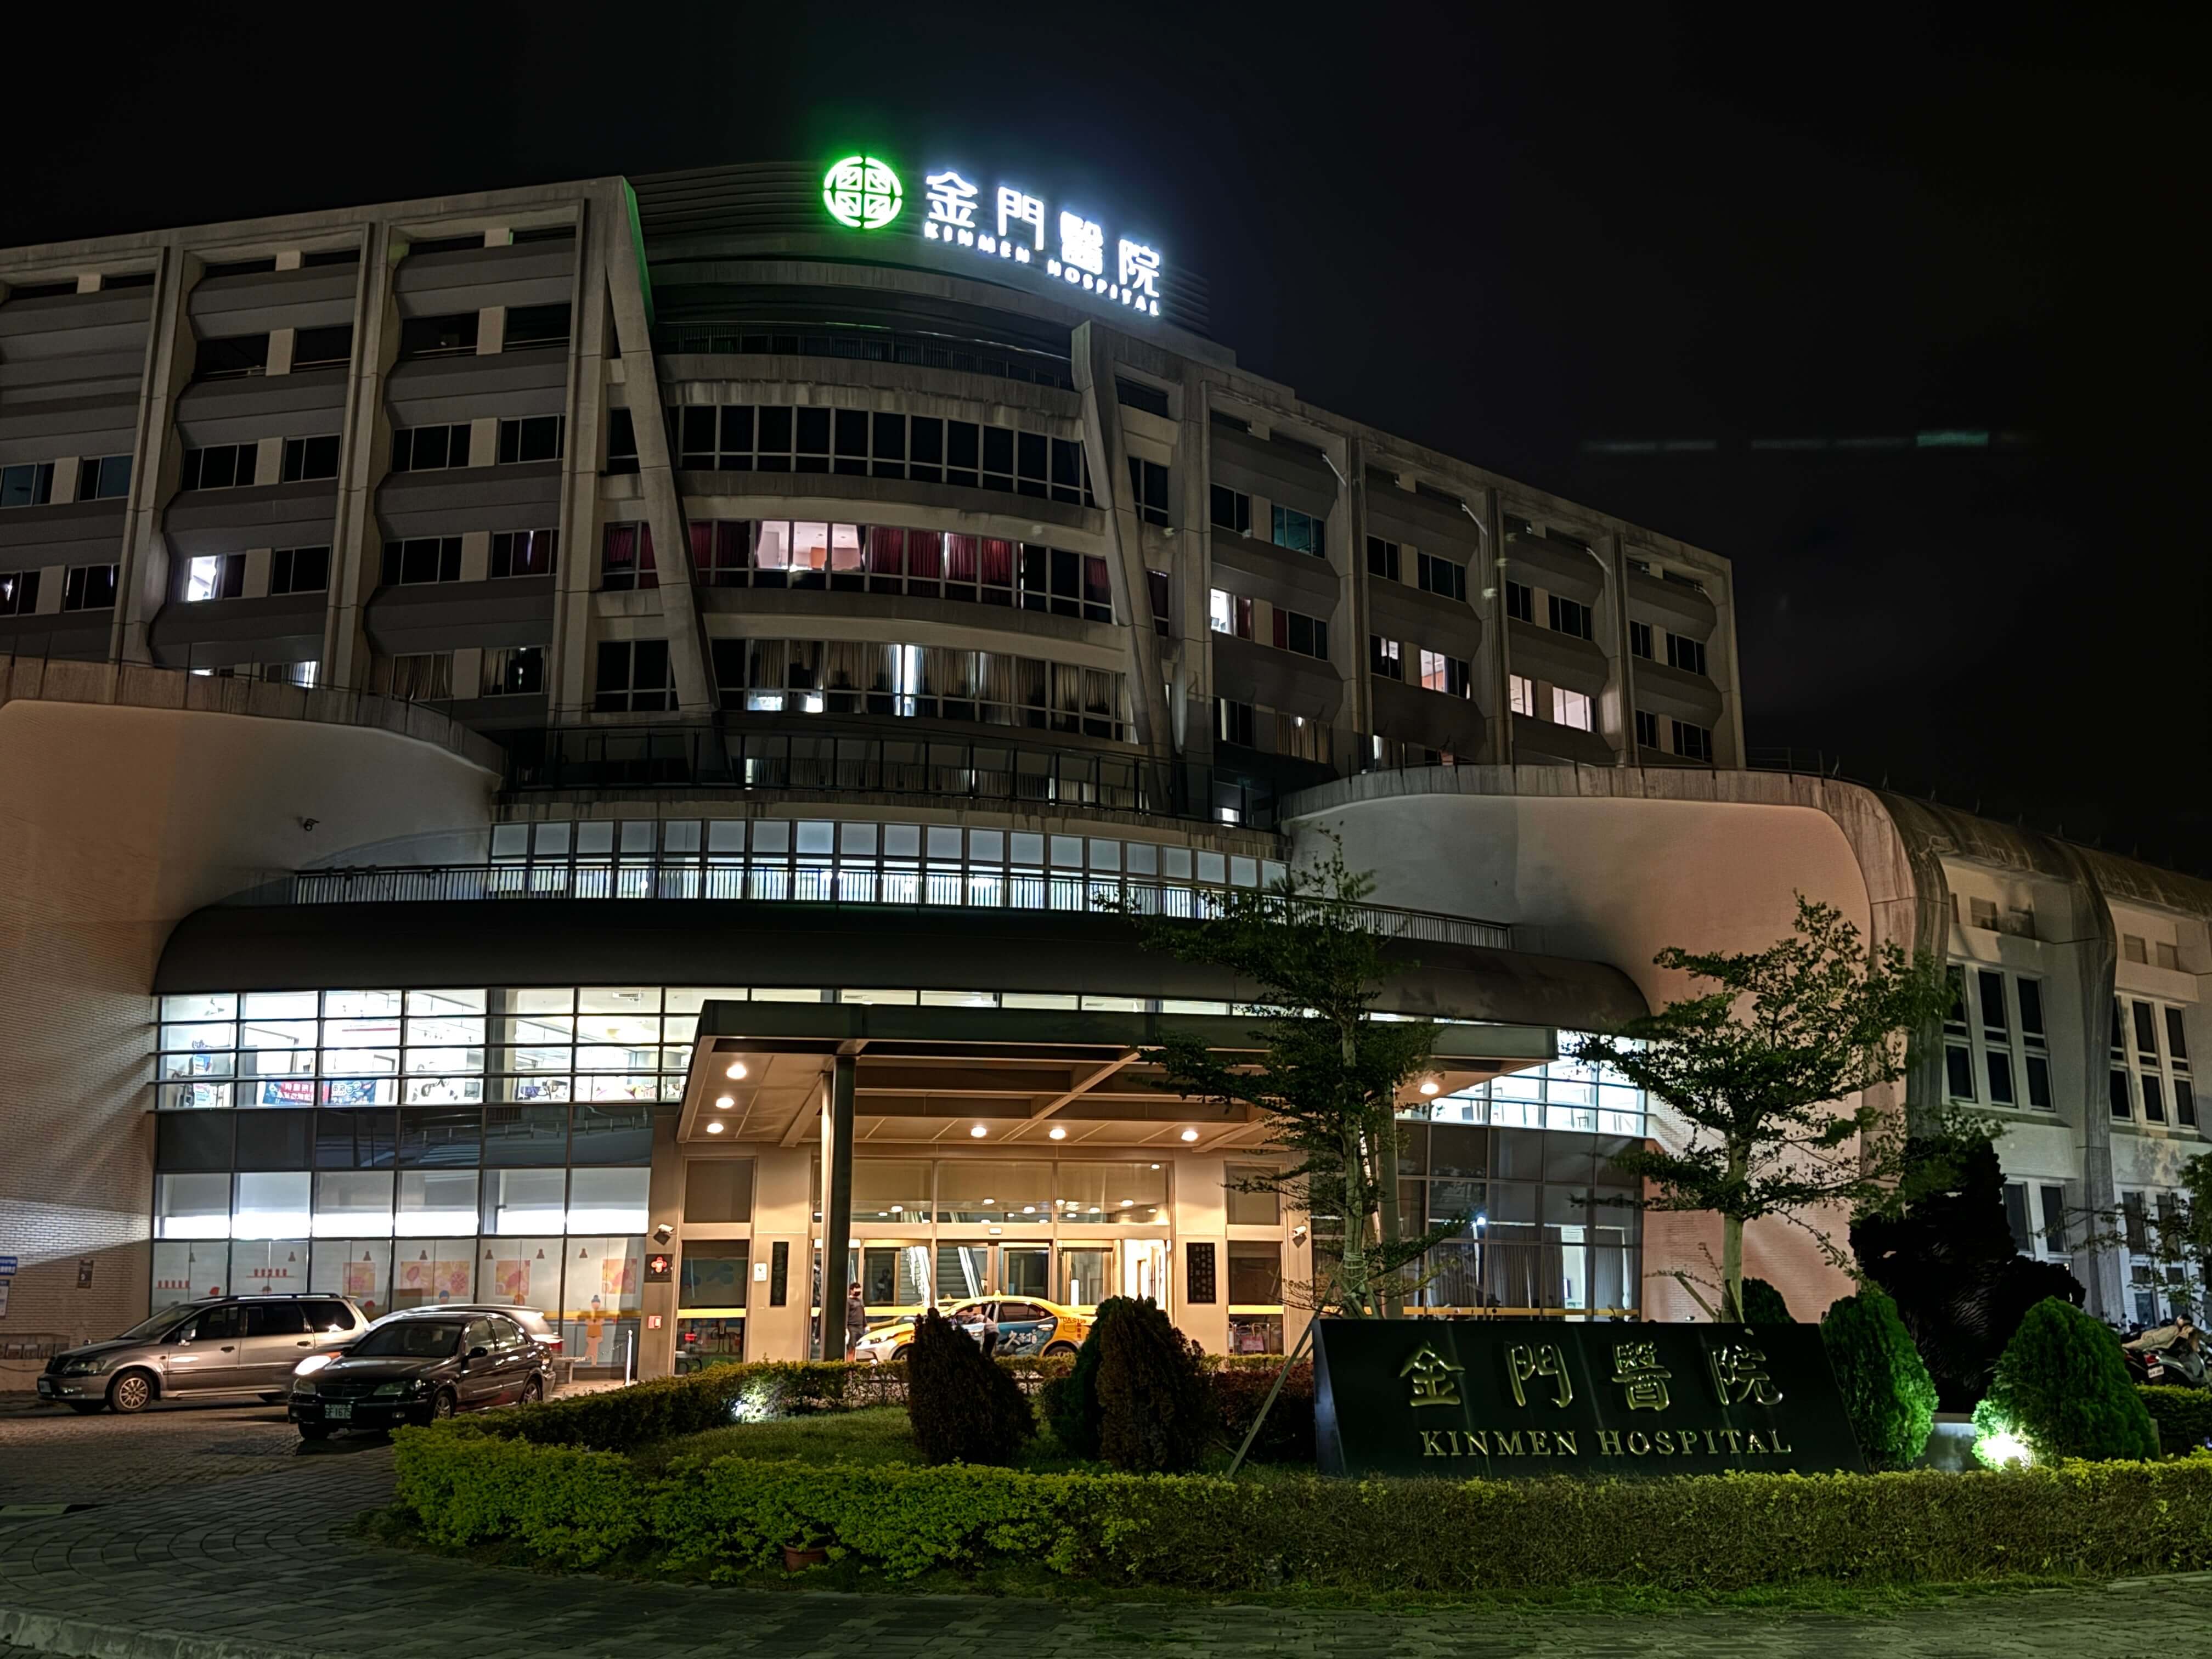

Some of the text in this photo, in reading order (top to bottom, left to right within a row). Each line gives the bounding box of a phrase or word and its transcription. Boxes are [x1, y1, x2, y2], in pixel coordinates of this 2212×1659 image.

[924, 221, 1159, 316] KINMEN HOSPITAL
[926, 172, 1160, 298] 金門醫院
[1400, 1341, 1783, 1411] 金門醫院
[1419, 1430, 1792, 1455] KINMEN HOSPITAL
